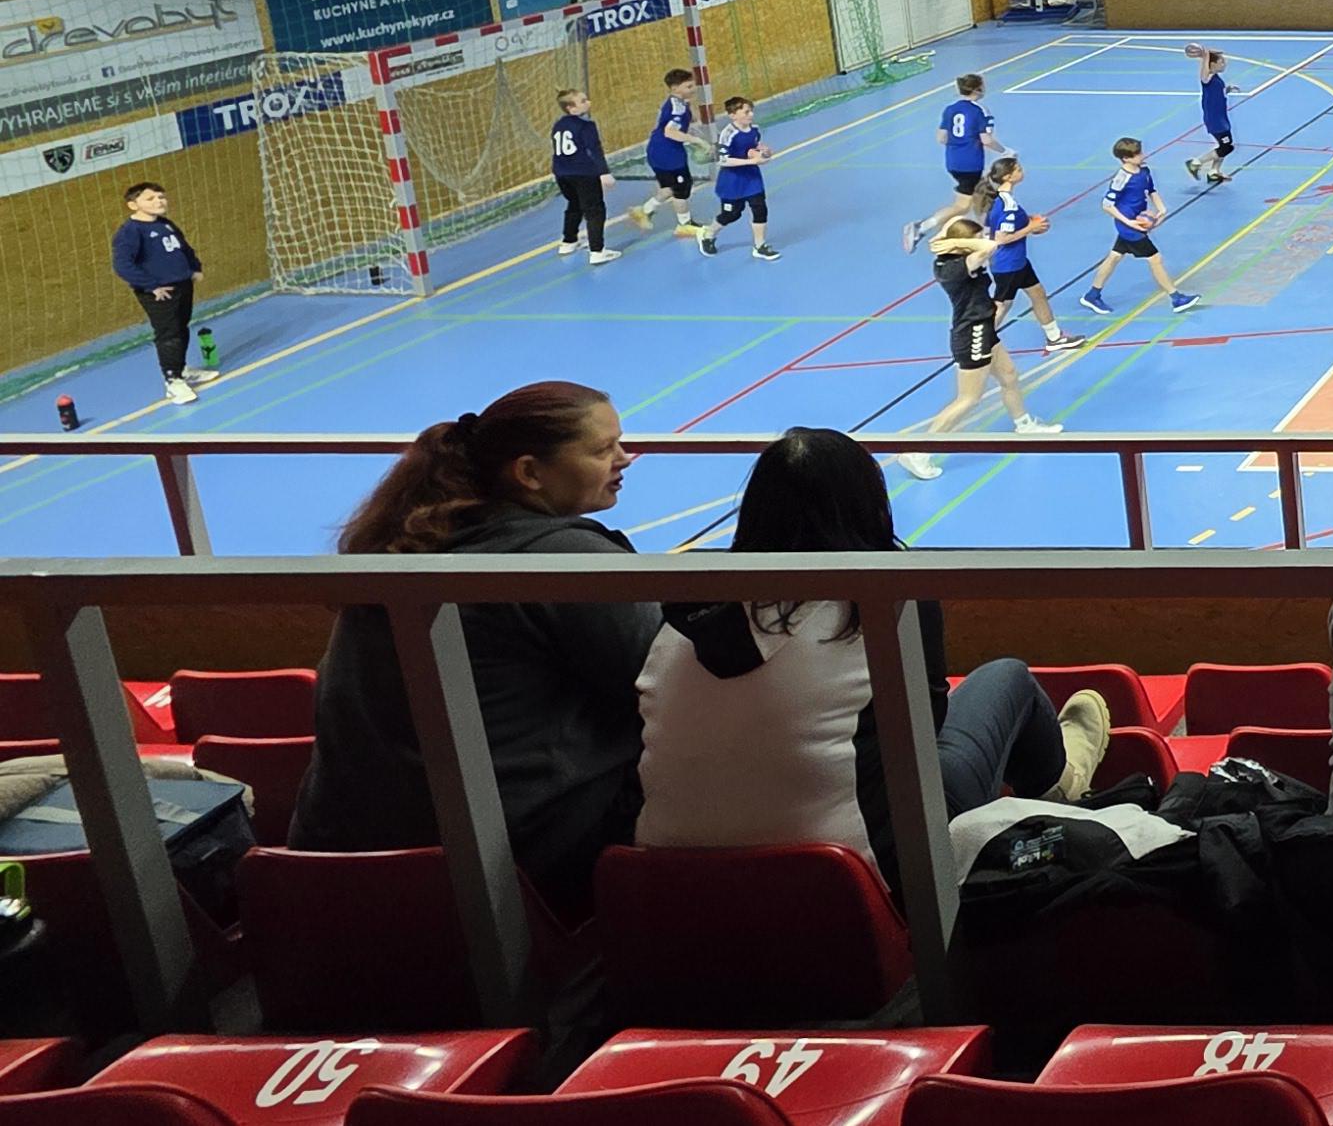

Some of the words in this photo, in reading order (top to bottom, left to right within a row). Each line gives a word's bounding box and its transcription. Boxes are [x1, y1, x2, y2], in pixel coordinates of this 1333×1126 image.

[213, 84, 311, 130] TROX
[554, 130, 577, 156] 16
[953, 113, 965, 138] 8
[256, 1038, 380, 1107] 50
